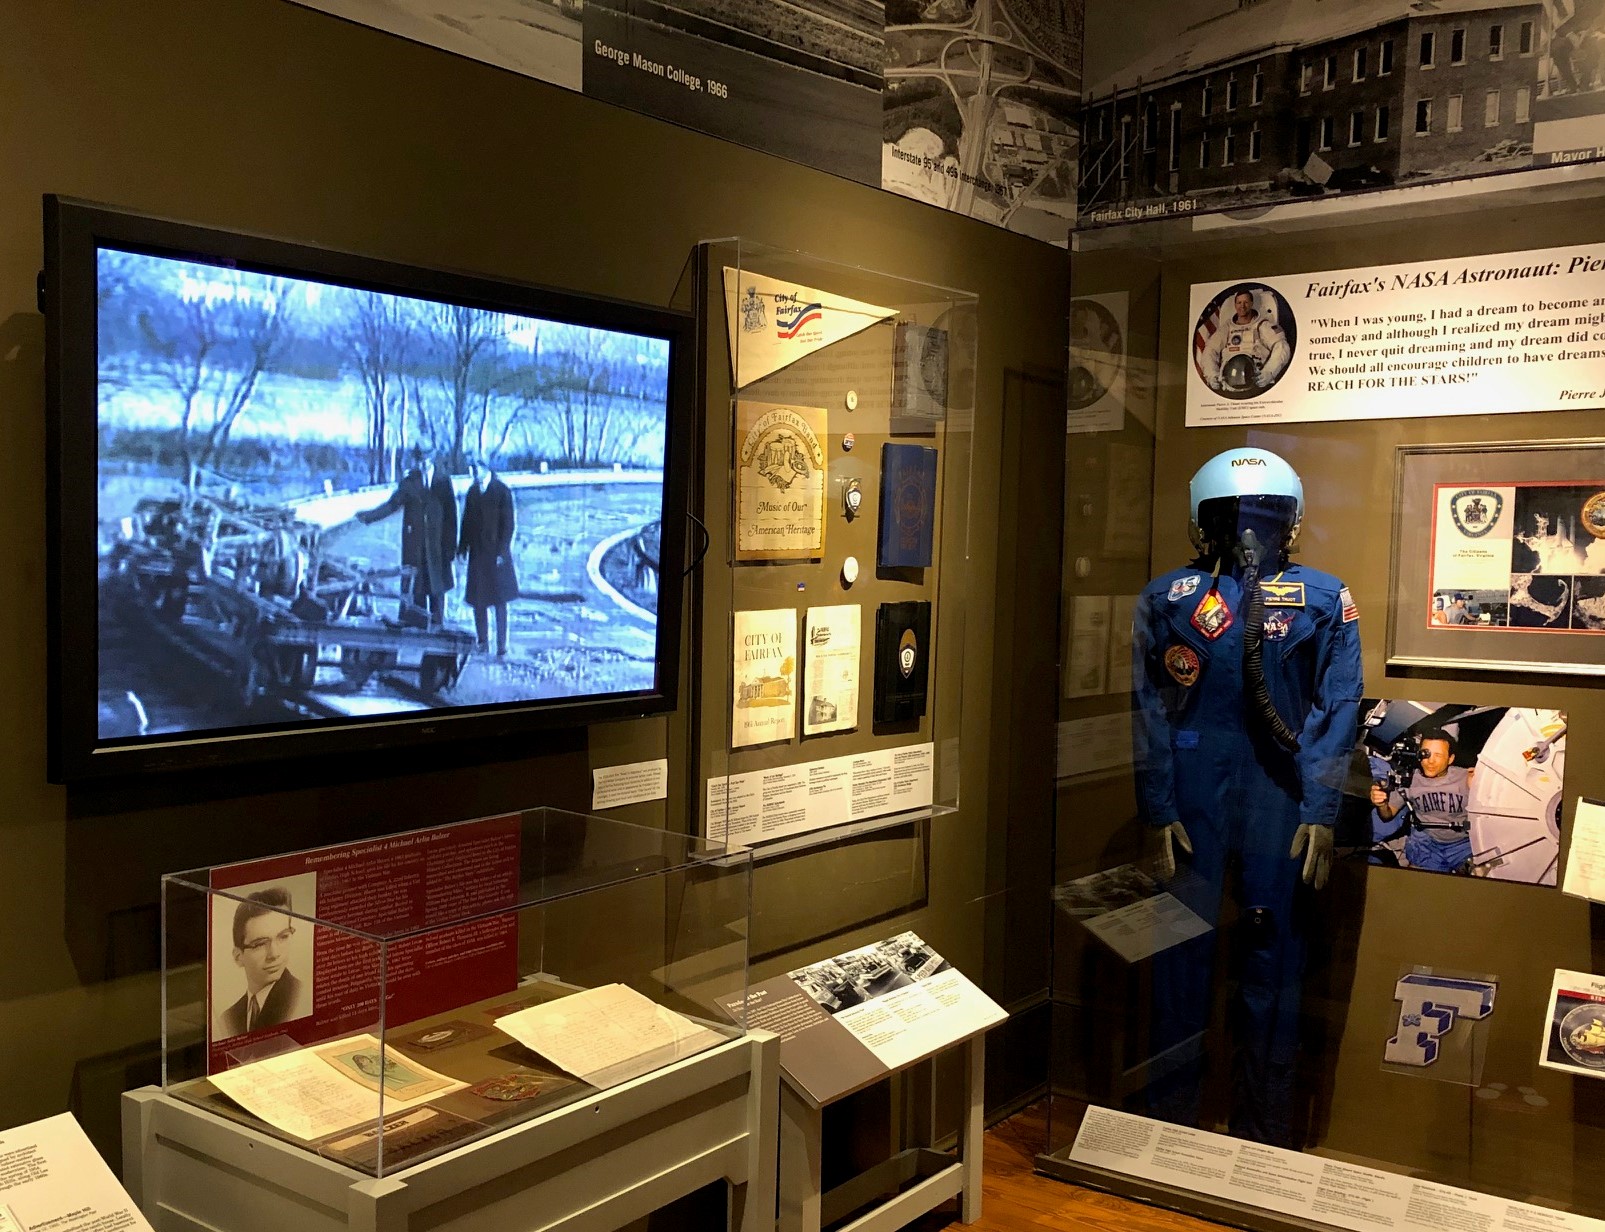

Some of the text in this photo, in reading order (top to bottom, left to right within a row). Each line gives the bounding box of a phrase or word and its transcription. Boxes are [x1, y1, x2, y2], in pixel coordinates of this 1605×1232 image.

[594, 40, 728, 98] George Mason College, 1966
[892, 146, 922, 166] Interstate
[924, 156, 932, 170] 95
[934, 162, 944, 174] and
[946, 166, 958, 178] 495
[1091, 199, 1197, 222] Fairfax City Hall, 1961
[1305, 276, 1386, 299] Fairfax's
[1390, 270, 1450, 290] NASA
[1452, 262, 1560, 285] Astronaut:
[774, 292, 798, 304] City of
[776, 304, 802, 316] Fairfax
[1310, 318, 1350, 328] "When
[1354, 316, 1358, 326] I
[1362, 316, 1384, 324] was
[1388, 313, 1427, 326] young,
[1431, 310, 1436, 320] I
[1440, 308, 1462, 319] had
[1477, 306, 1518, 316] dream
[1522, 302, 1534, 312] to
[1538, 298, 1588, 310] become
[1309, 333, 1358, 344] someday
[1361, 330, 1382, 341] and
[1386, 326, 1438, 339] although
[1443, 326, 1447, 335] I
[1452, 321, 1500, 334] realized
[1504, 321, 1524, 332] my
[1528, 318, 1570, 328] dream
[1308, 350, 1335, 361] true,
[1339, 348, 1343, 358] I
[1347, 349, 1378, 358] never
[1381, 345, 1404, 358] quit
[1408, 342, 1466, 354] dreaming
[1470, 338, 1492, 350] and
[1497, 339, 1516, 350] my
[1520, 336, 1562, 346] dream
[1567, 331, 1588, 342] did
[1308, 366, 1326, 376] We
[1329, 364, 1366, 375] should
[1370, 362, 1384, 372] all
[1388, 360, 1448, 372] encourage
[1452, 356, 1502, 368] children
[1508, 354, 1520, 364] to
[1524, 353, 1554, 362] have
[1308, 372, 1478, 392] REACH FOR THE STARS!"
[1559, 390, 1597, 400] Pierre
[762, 416, 770, 427] of
[771, 412, 800, 426] Fairfax
[1232, 458, 1267, 468] NASA
[756, 502, 808, 514] Music of Our
[748, 524, 816, 537] American Heritage
[1264, 622, 1288, 634] NASA
[744, 632, 782, 646] CITY OF
[744, 646, 783, 661] FAIRFAX
[1414, 792, 1464, 814] FAIRFAX
[305, 850, 350, 865] Remembering
[352, 844, 382, 857] Specialist
[389, 838, 414, 850] Michael
[727, 1000, 744, 1008] Parade
[1385, 974, 1497, 1067] F
[362, 1120, 410, 1138] BAZER
